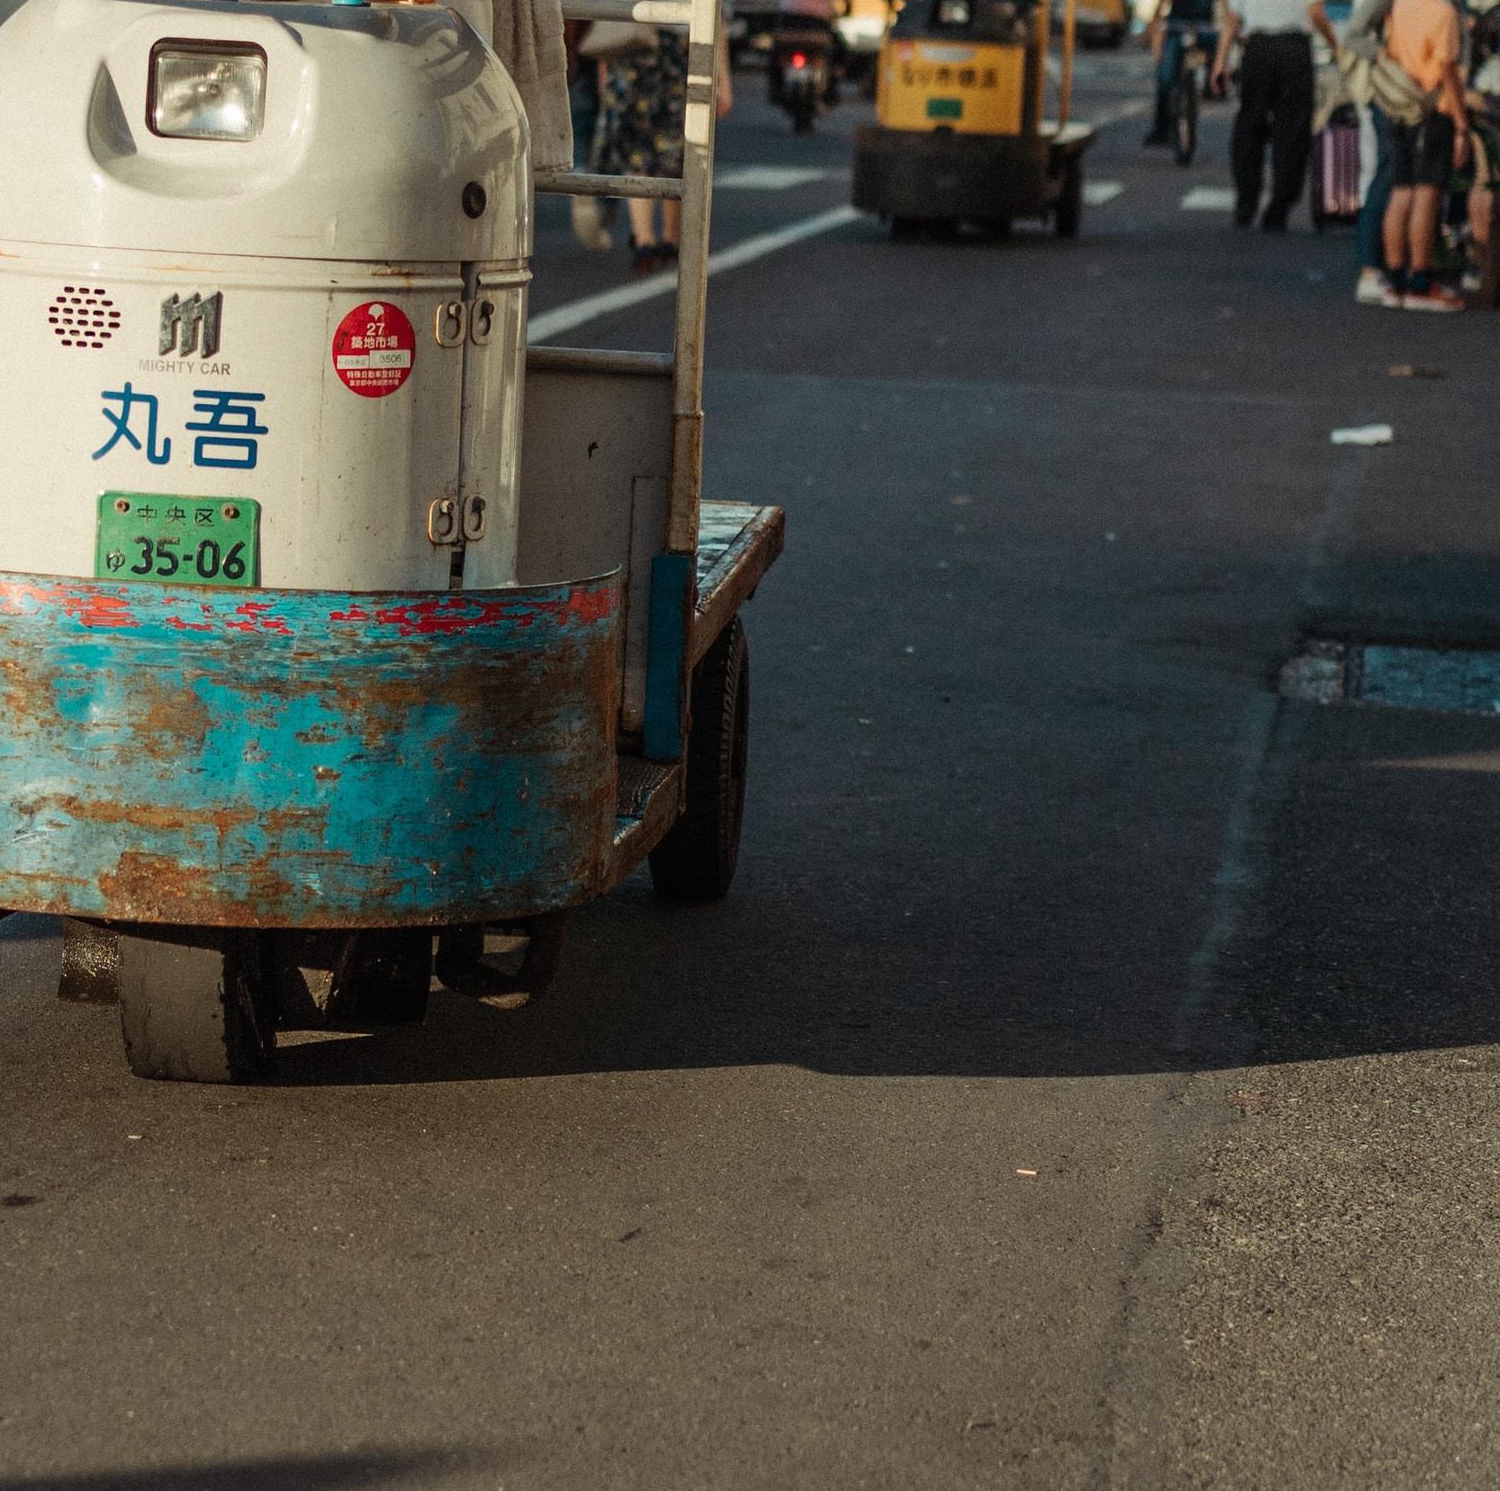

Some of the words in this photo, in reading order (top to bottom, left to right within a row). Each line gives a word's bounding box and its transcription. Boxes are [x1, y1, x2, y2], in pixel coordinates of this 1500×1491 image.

[367, 322, 385, 336] 27
[351, 335, 398, 349] 築地市場
[140, 360, 195, 374] MIGHTY
[200, 363, 231, 375] CAR
[91, 381, 269, 469] 丸吾
[137, 504, 215, 527] 中央区
[131, 536, 246, 580] 35-06
